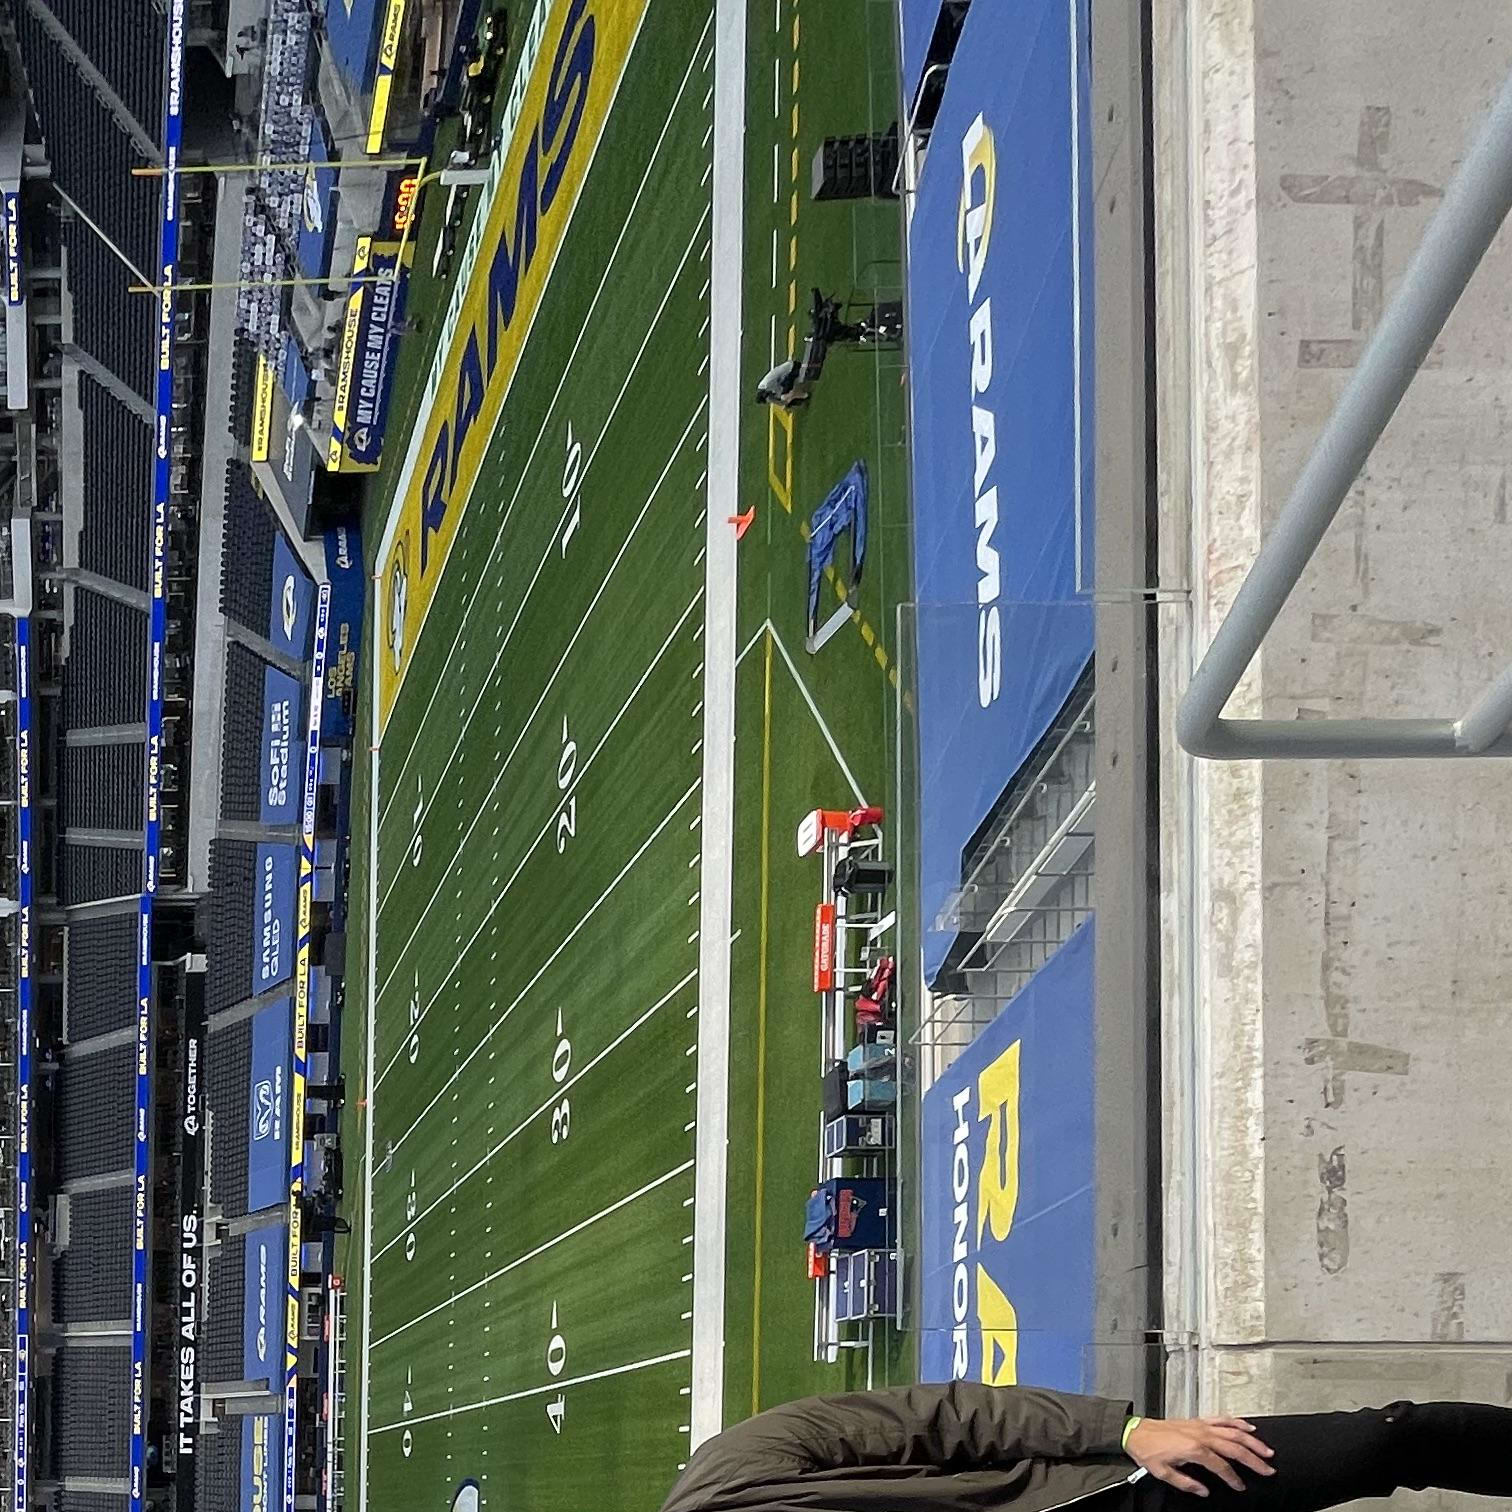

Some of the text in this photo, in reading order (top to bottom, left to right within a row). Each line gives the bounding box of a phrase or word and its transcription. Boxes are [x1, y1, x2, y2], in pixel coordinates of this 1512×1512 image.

[388, 3, 401, 42] RAMS
[8, 198, 18, 301] BUILT FOR LA
[420, 0, 595, 580] RAMS
[337, 308, 358, 412] #RAMSHOUSE
[354, 268, 394, 424] MY CAUSE MY CLEATS
[561, 442, 582, 557] 10
[968, 297, 1001, 708] RAMS
[154, 503, 164, 598] BUILT FOR LA
[327, 666, 336, 698] LOS
[269, 740, 280, 806] SoFi
[278, 700, 290, 806] Stadium
[556, 739, 578, 853] 20
[262, 856, 274, 979] SAMSUNG
[270, 919, 280, 976] QLED
[820, 923, 829, 972] GATORADE
[187, 1038, 198, 1113] TOGETHER
[274, 1066, 282, 1140] RAM
[551, 1034, 572, 1144] 30
[183, 1210, 197, 1249] US.
[182, 1253, 197, 1290] OF
[258, 1244, 266, 1326] RAMS
[181, 1293, 196, 1340] ALL
[179, 1347, 195, 1427] TAKES
[546, 1333, 566, 1433] 40
[179, 1431, 194, 1454] IT
